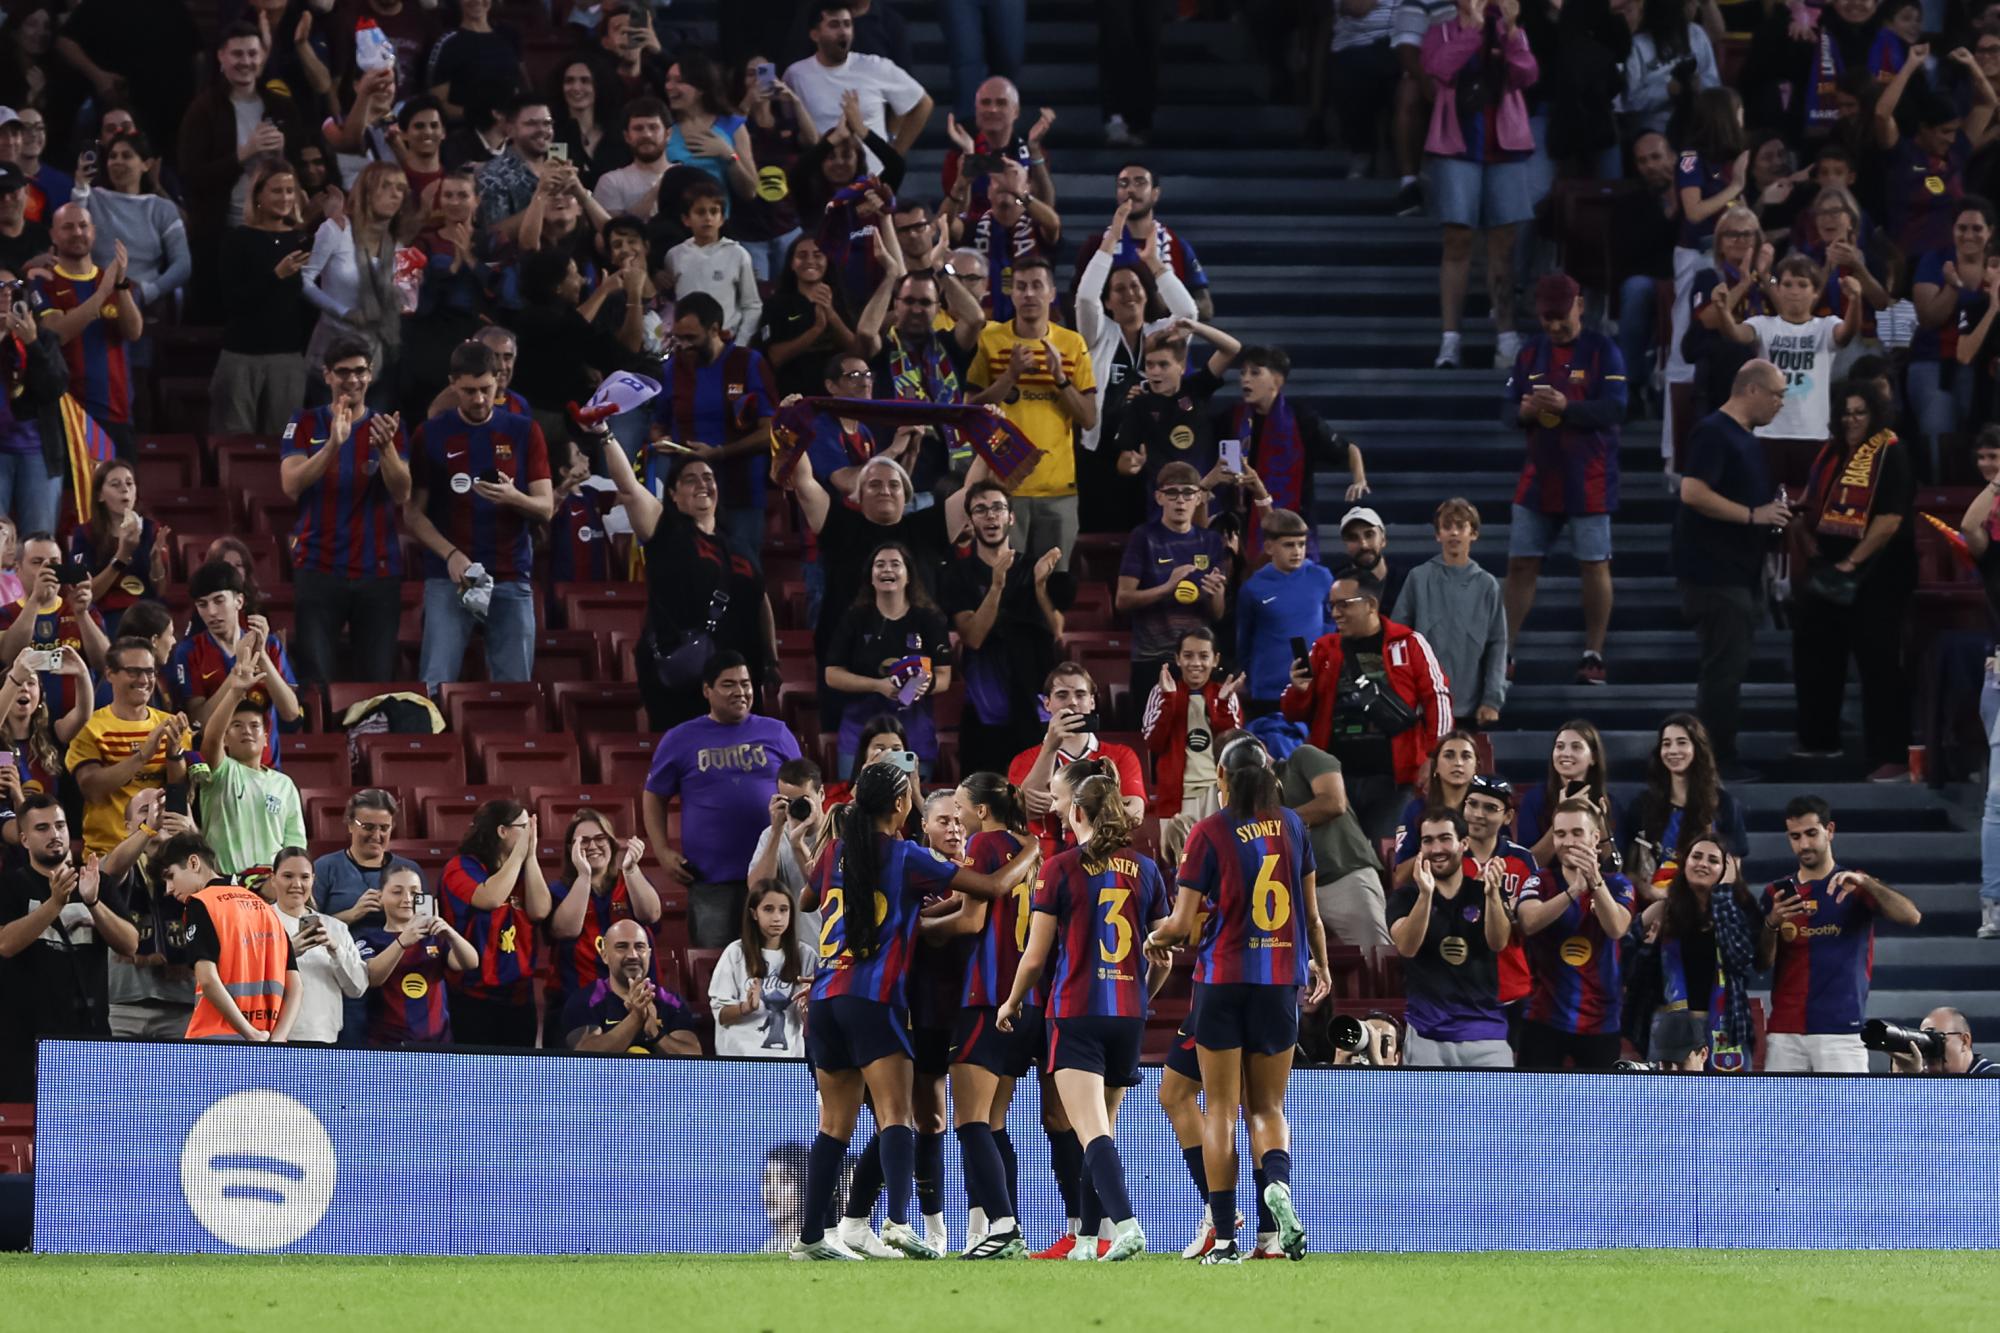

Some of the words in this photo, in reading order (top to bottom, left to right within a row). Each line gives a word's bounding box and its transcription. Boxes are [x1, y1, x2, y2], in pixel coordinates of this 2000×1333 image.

[1769, 349, 1815, 371] YOUR
[1236, 820, 1281, 843] SYDNEY
[1252, 853, 1291, 931] 6
[1098, 887, 1132, 963] 3
[1800, 924, 1841, 937] Spotify
